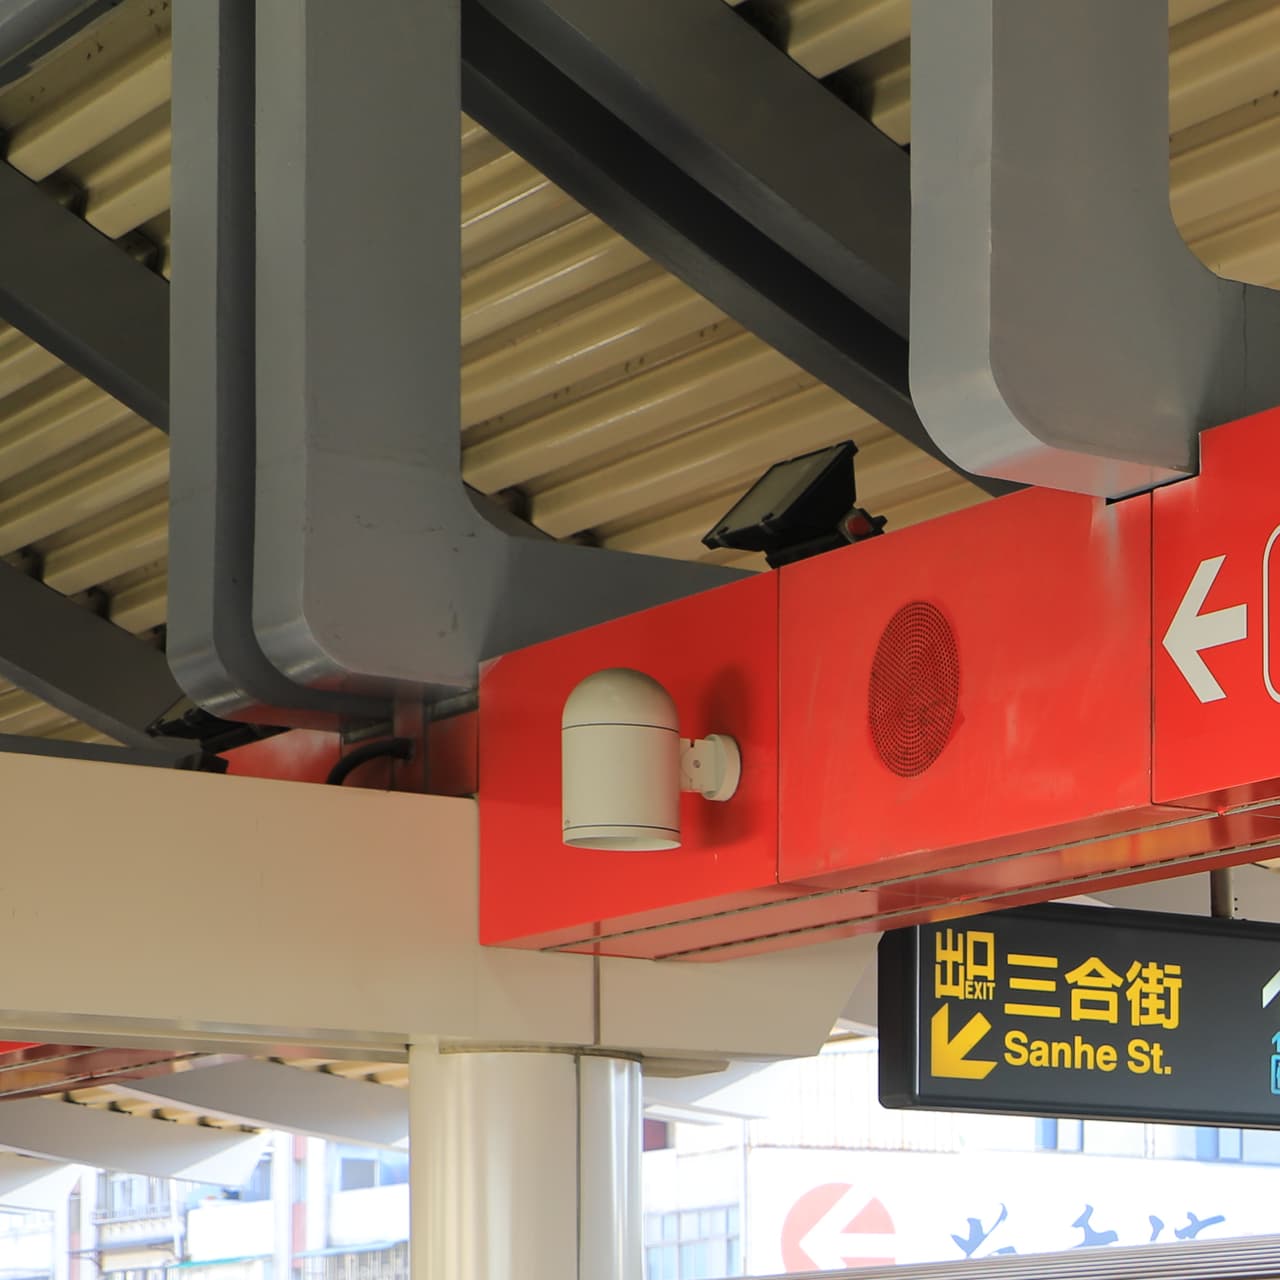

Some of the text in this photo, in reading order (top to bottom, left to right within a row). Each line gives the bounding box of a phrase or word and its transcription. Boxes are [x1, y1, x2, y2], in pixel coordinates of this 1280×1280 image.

[935, 928, 995, 1000] 出口
[965, 980, 996, 1000] EXIT
[1004, 954, 1182, 1029] 三合街
[1004, 1030, 1172, 1074] Sanhe St.
